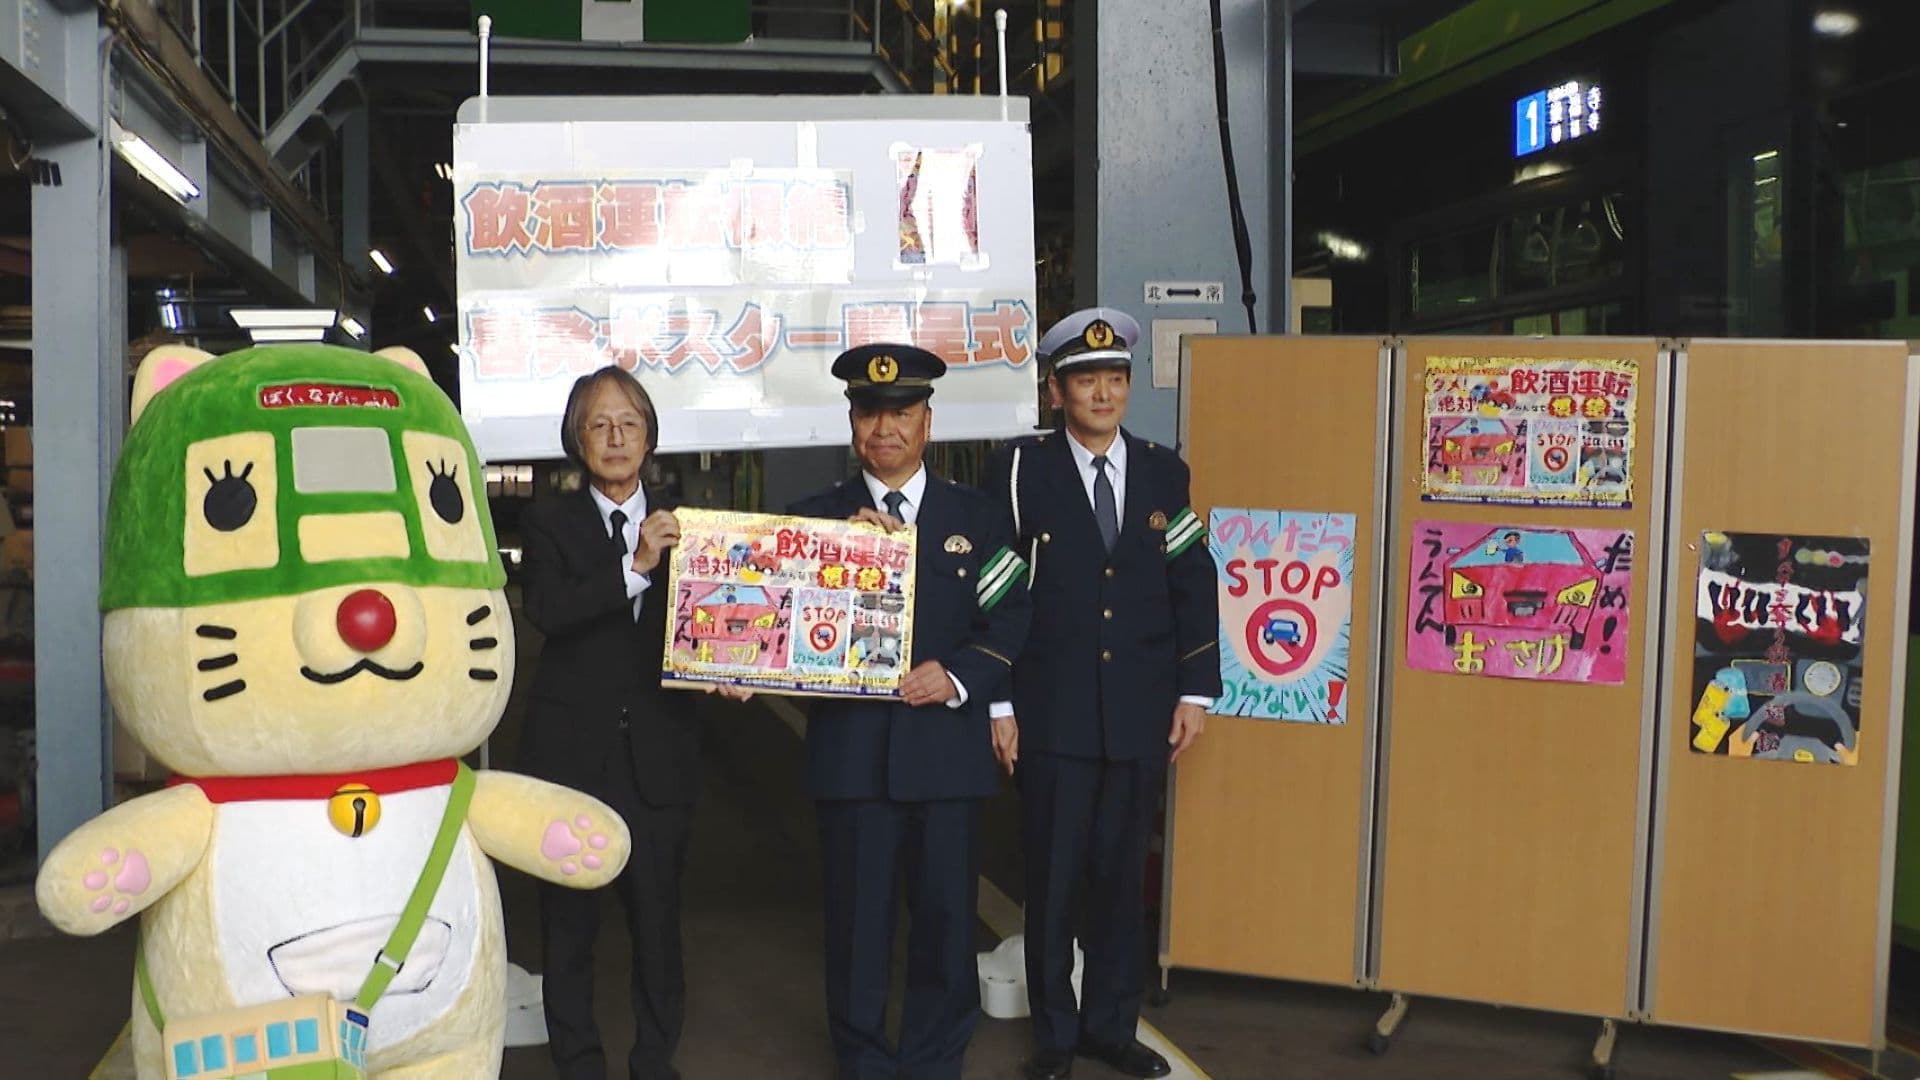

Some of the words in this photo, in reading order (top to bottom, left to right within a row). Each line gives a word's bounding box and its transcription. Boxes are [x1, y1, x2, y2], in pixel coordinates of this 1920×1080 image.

[1525, 99, 1538, 147] 1
[1511, 369, 1633, 399] 飲酒運転
[776, 529, 910, 571] 飲酒運転
[1217, 514, 1351, 553] のんだら
[1225, 558, 1341, 601] STOP
[802, 605, 847, 624] STOP
[1452, 631, 1571, 675] おさけ
